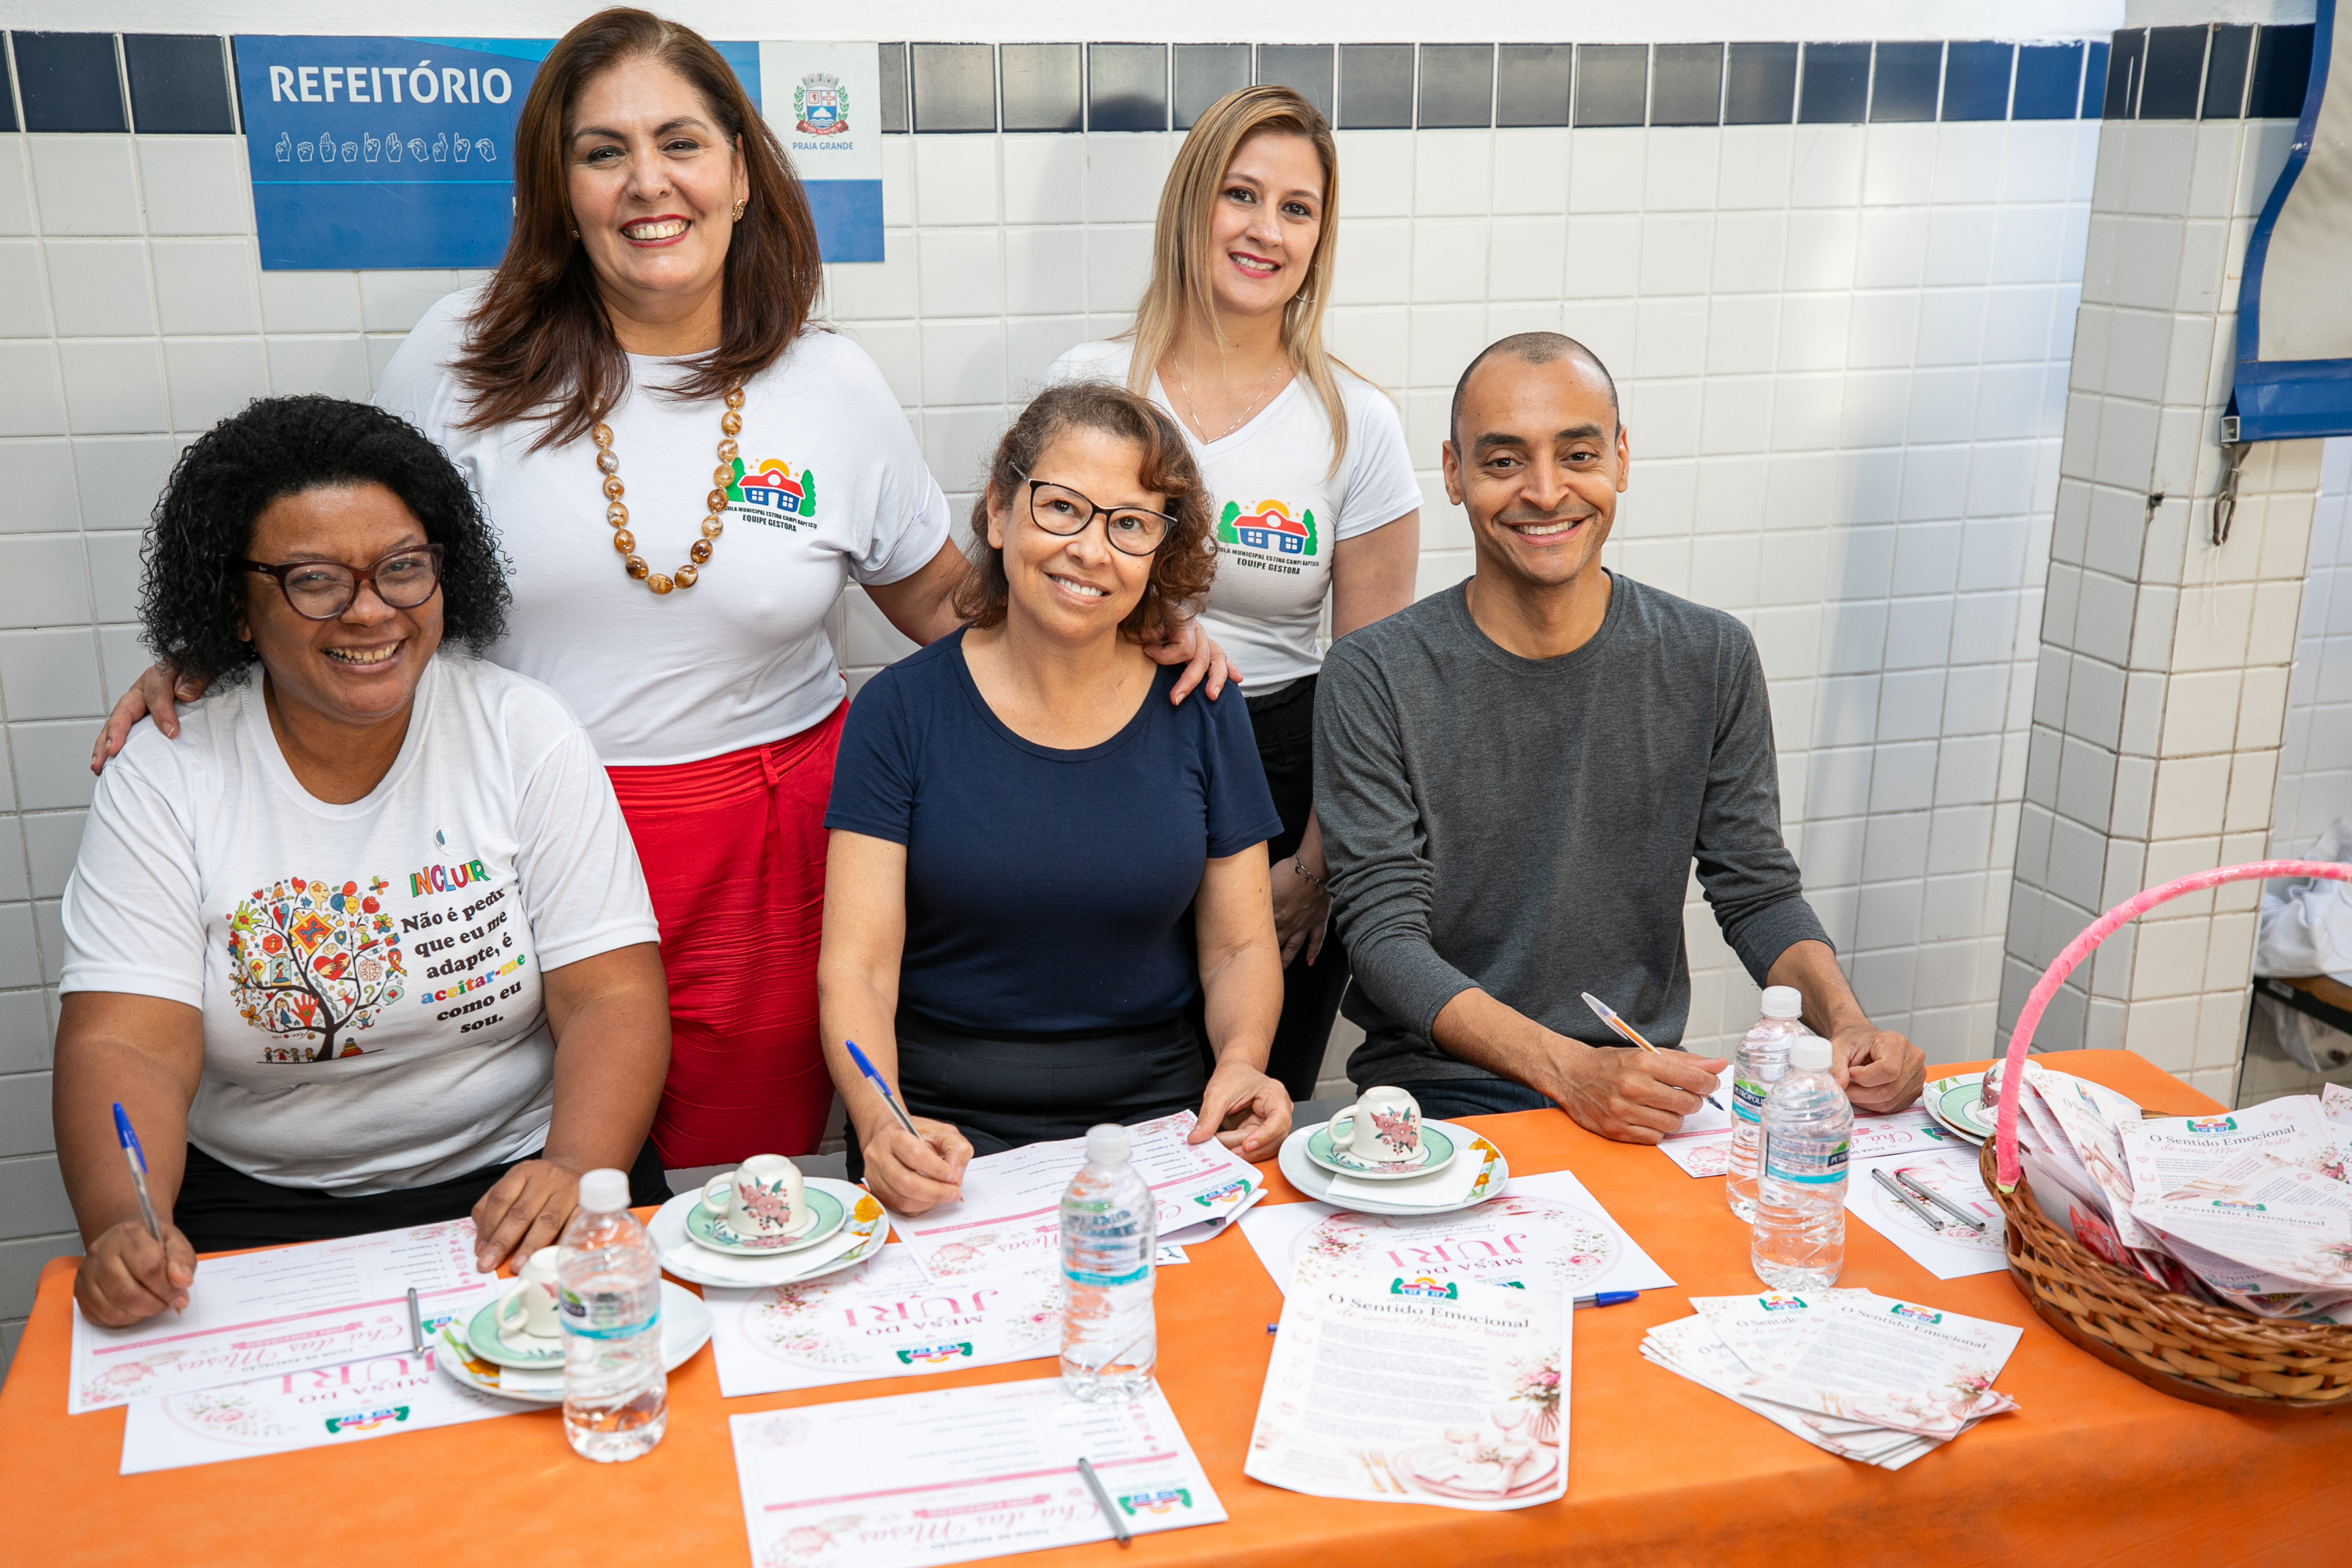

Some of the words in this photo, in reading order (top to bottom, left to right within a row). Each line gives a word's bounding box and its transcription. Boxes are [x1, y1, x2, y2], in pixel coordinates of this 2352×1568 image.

[270, 60, 513, 103] REFEITÓRIO
[739, 507, 765, 516] MUNICIPAL
[743, 514, 767, 525] EQUIPE
[768, 520, 797, 532] GESTORA
[1232, 550, 1265, 560] MUNICIPAL
[1266, 555, 1285, 564] ESTINA
[1237, 557, 1266, 569] EQUIPE
[1269, 564, 1300, 575] GESTORA
[410, 859, 491, 898] INCLUIR
[401, 911, 443, 935] Não
[448, 908, 458, 922] é
[462, 887, 506, 920] pedir
[415, 938, 454, 959] que
[459, 927, 485, 944] eu
[487, 909, 508, 934] me
[426, 946, 501, 979] adapte,
[502, 934, 513, 949] é
[421, 951, 526, 1005] aceitar-me
[436, 994, 495, 1022] como
[499, 980, 522, 1002] eu
[460, 1014, 504, 1034] sou.
[2063, 1098, 2072, 1108] O
[1866, 1131, 1912, 1144] Chá
[2161, 1143, 2176, 1152] de
[2252, 1137, 2292, 1149] Posta
[2166, 1135, 2220, 1147] Sentido
[2223, 1125, 2296, 1146] Emocional
[1150, 1151, 1174, 1160] Fidelidade
[1151, 1158, 1180, 1167] Organização
[2183, 1206, 2241, 1216] Sentido
[2246, 1212, 2325, 1226] Emocional
[1386, 1233, 1526, 1269] JÚRI
[1417, 1266, 1448, 1275] DO
[1458, 1258, 1523, 1271] MESA
[845, 1290, 998, 1327] JÚRI
[1329, 1293, 1344, 1304] O
[1351, 1298, 1423, 1316] Sentido
[1431, 1307, 1529, 1328] Emocional
[913, 1316, 982, 1330] MESA
[1337, 1308, 1356, 1318] de
[1363, 1315, 1399, 1324] uma
[1406, 1316, 1457, 1331] Mesa
[1465, 1326, 1519, 1338] Posta
[1751, 1316, 1799, 1326] Sentido
[1857, 1310, 1909, 1329] Sentido
[1914, 1326, 1987, 1349] Emocional
[345, 1325, 403, 1348] Chá
[866, 1326, 900, 1337] DO
[289, 1337, 334, 1355] das
[321, 1348, 353, 1358] FICHA
[172, 1348, 277, 1372] Mesas
[241, 1357, 300, 1372] AVALIAÇÃO
[283, 1351, 435, 1395] JÚRI
[353, 1377, 429, 1395] MESA
[299, 1392, 336, 1404] DO
[976, 1511, 1025, 1529] das
[1040, 1501, 1100, 1524] Chá
[858, 1521, 966, 1544] Mesas
